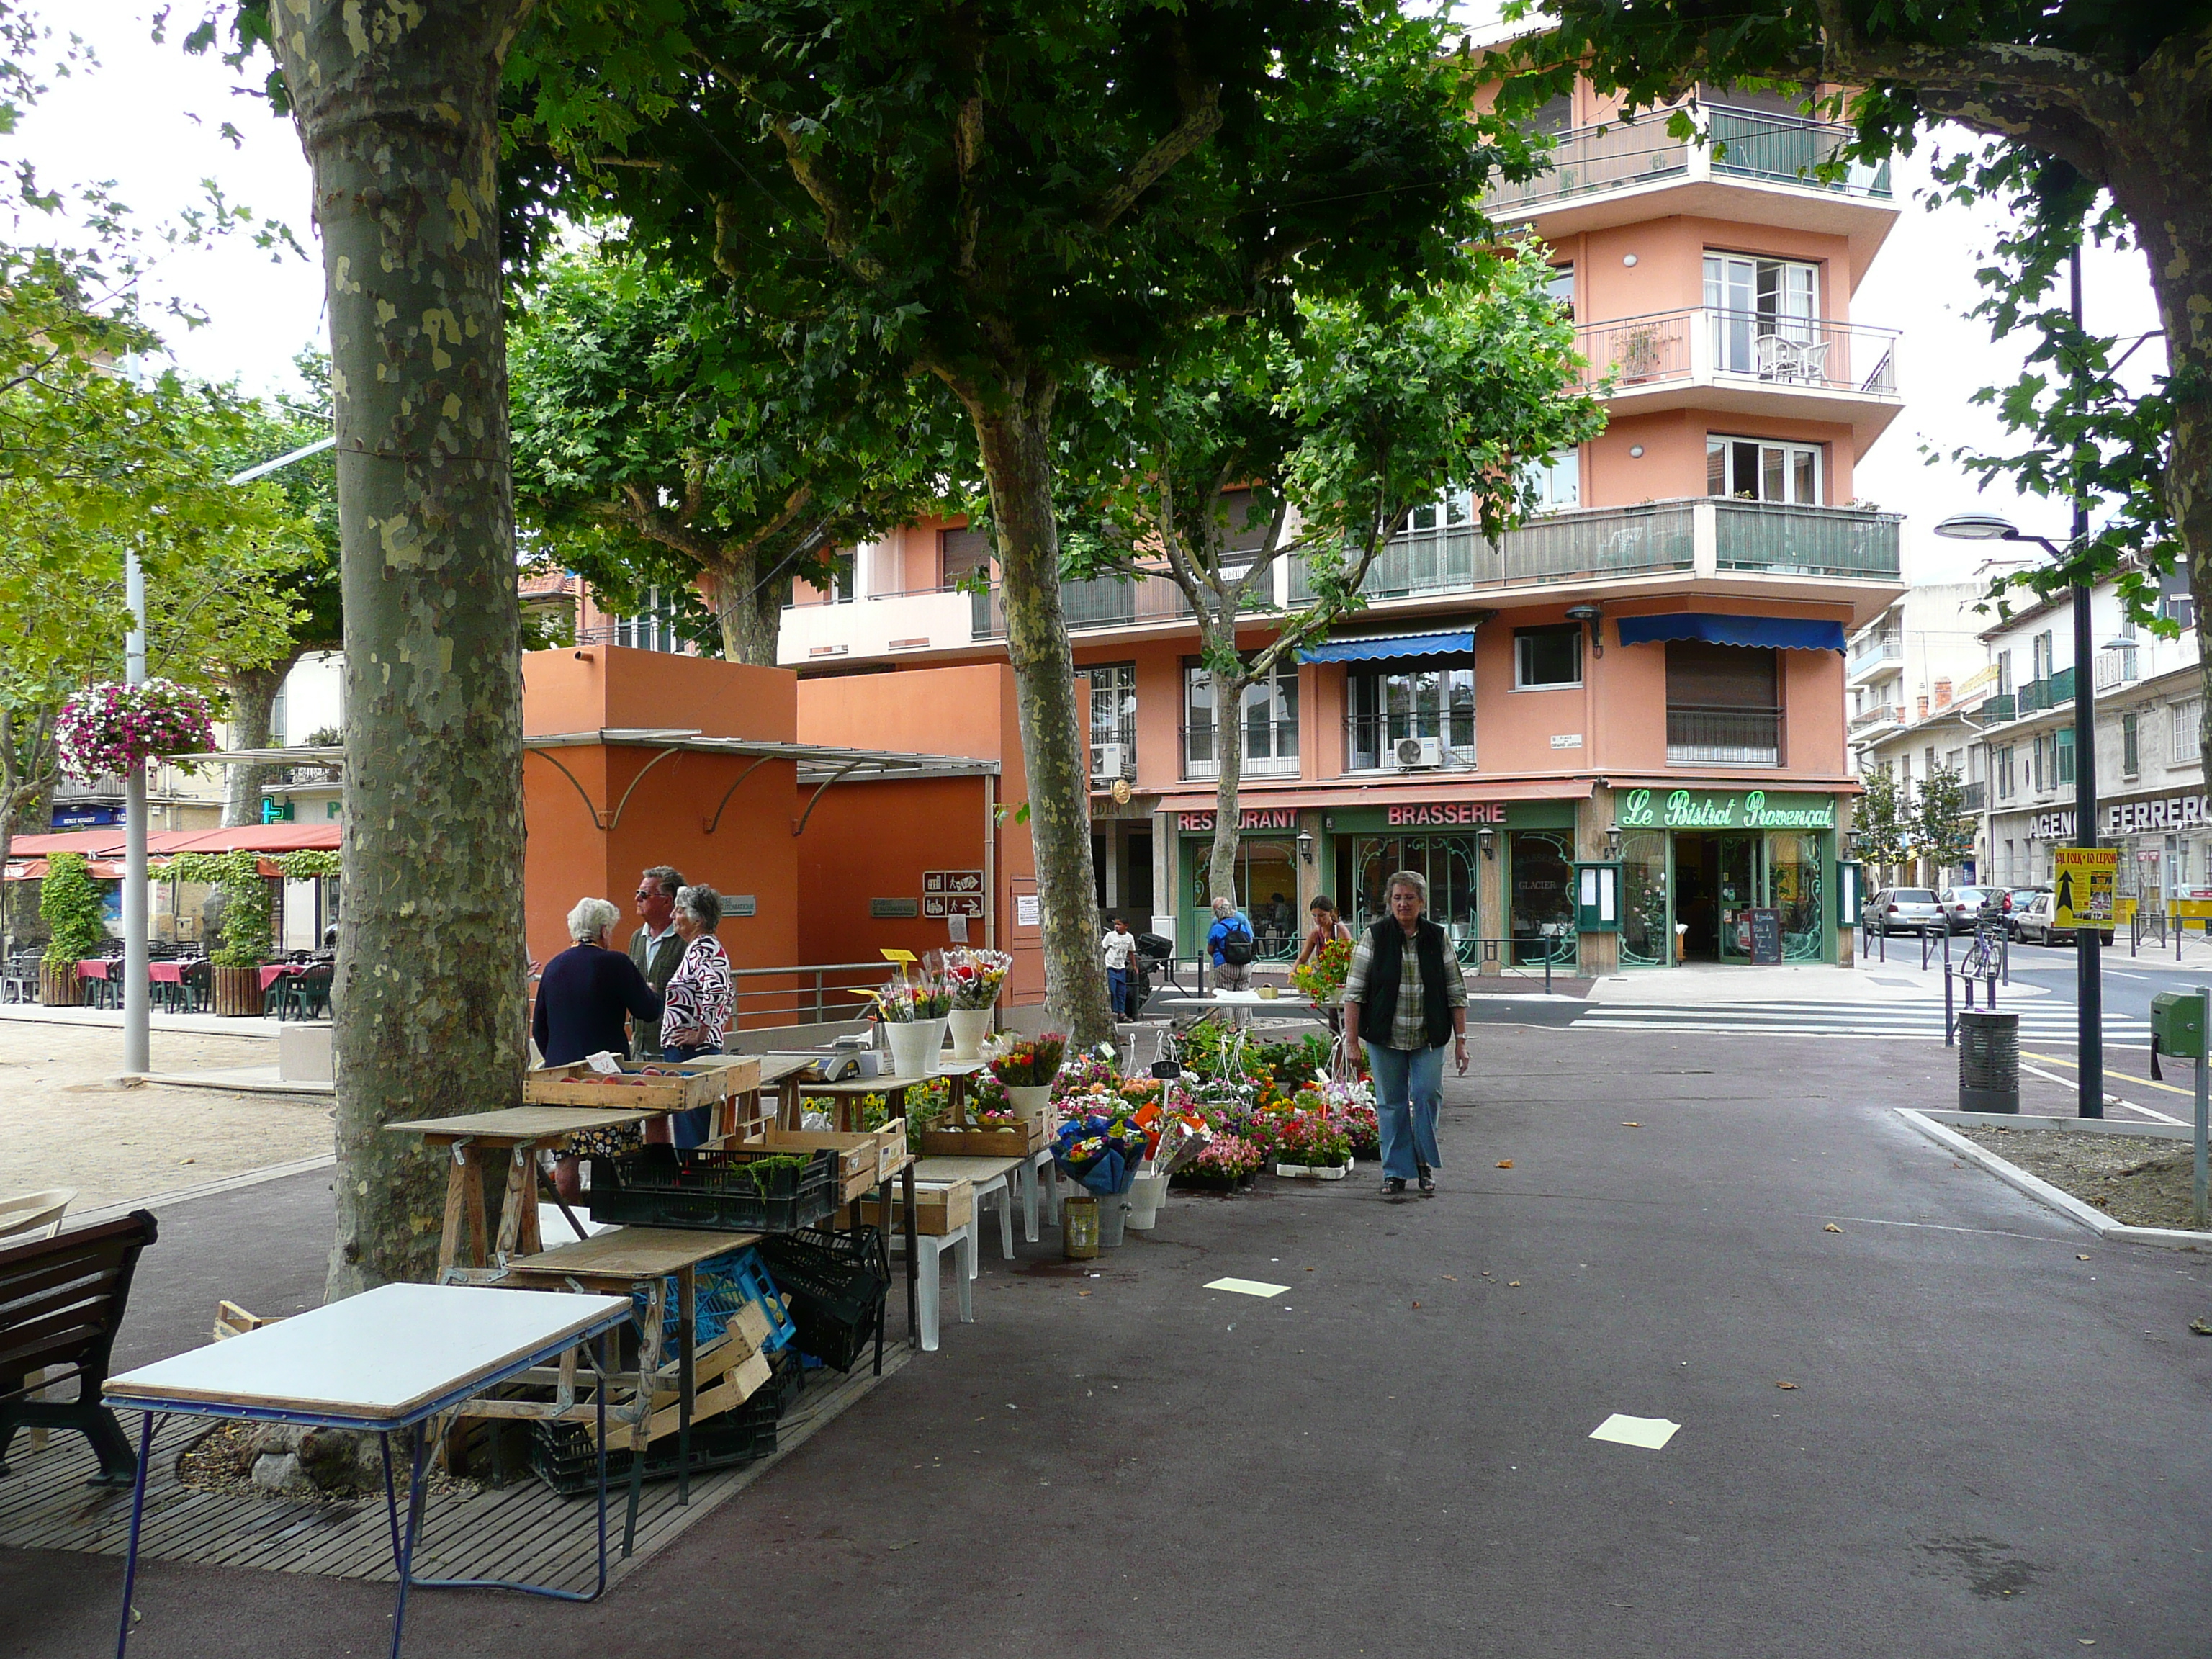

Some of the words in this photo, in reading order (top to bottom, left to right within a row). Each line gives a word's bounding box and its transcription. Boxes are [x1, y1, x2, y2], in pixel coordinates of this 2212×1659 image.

[1388, 803, 1507, 825] BRASSERIE
[1622, 789, 1653, 825] Le
[1664, 790, 1735, 826] Bistrot
[1743, 790, 1835, 827] Provençal
[1177, 809, 1298, 831] RESURANT
[2029, 810, 2077, 835] AGEN
[1519, 881, 1557, 890] GLACIER
